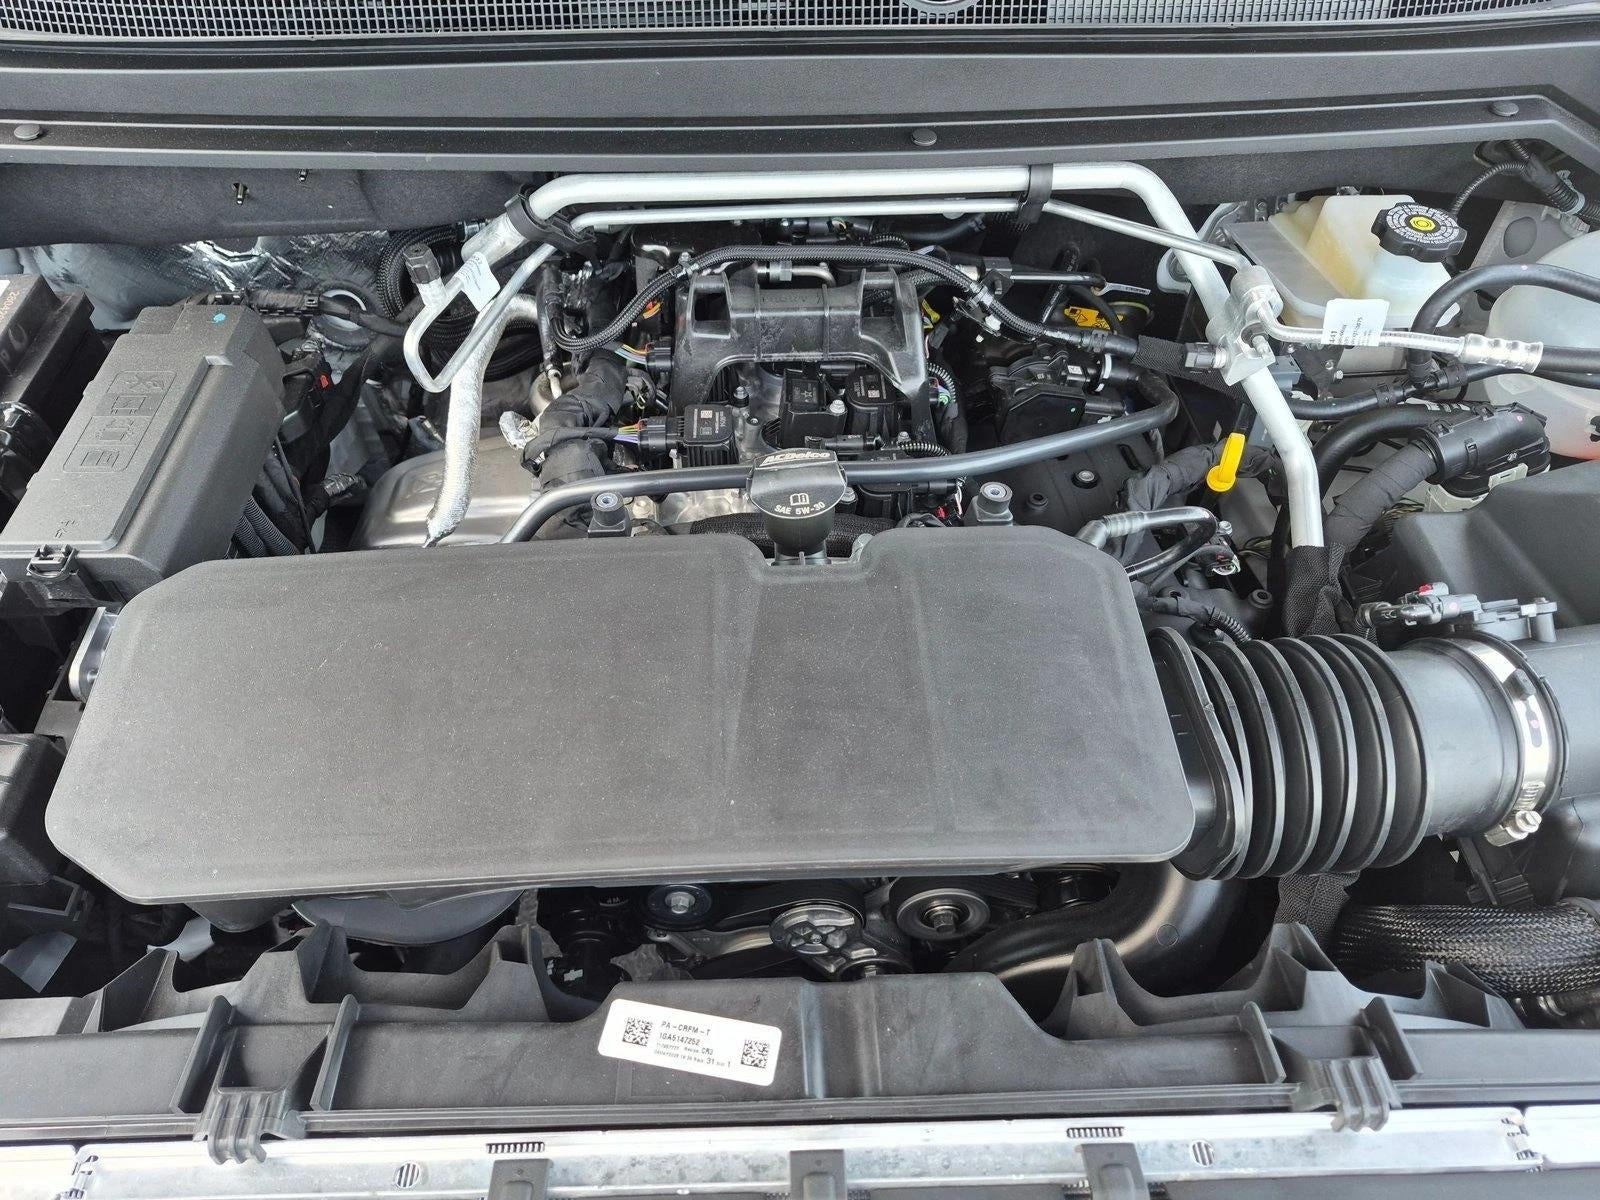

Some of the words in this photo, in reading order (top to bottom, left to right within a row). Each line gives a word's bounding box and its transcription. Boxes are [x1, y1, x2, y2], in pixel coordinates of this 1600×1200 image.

[759, 451, 831, 467] ACDelco
[774, 504, 792, 515] SAE
[795, 501, 826, 515] 5W-30
